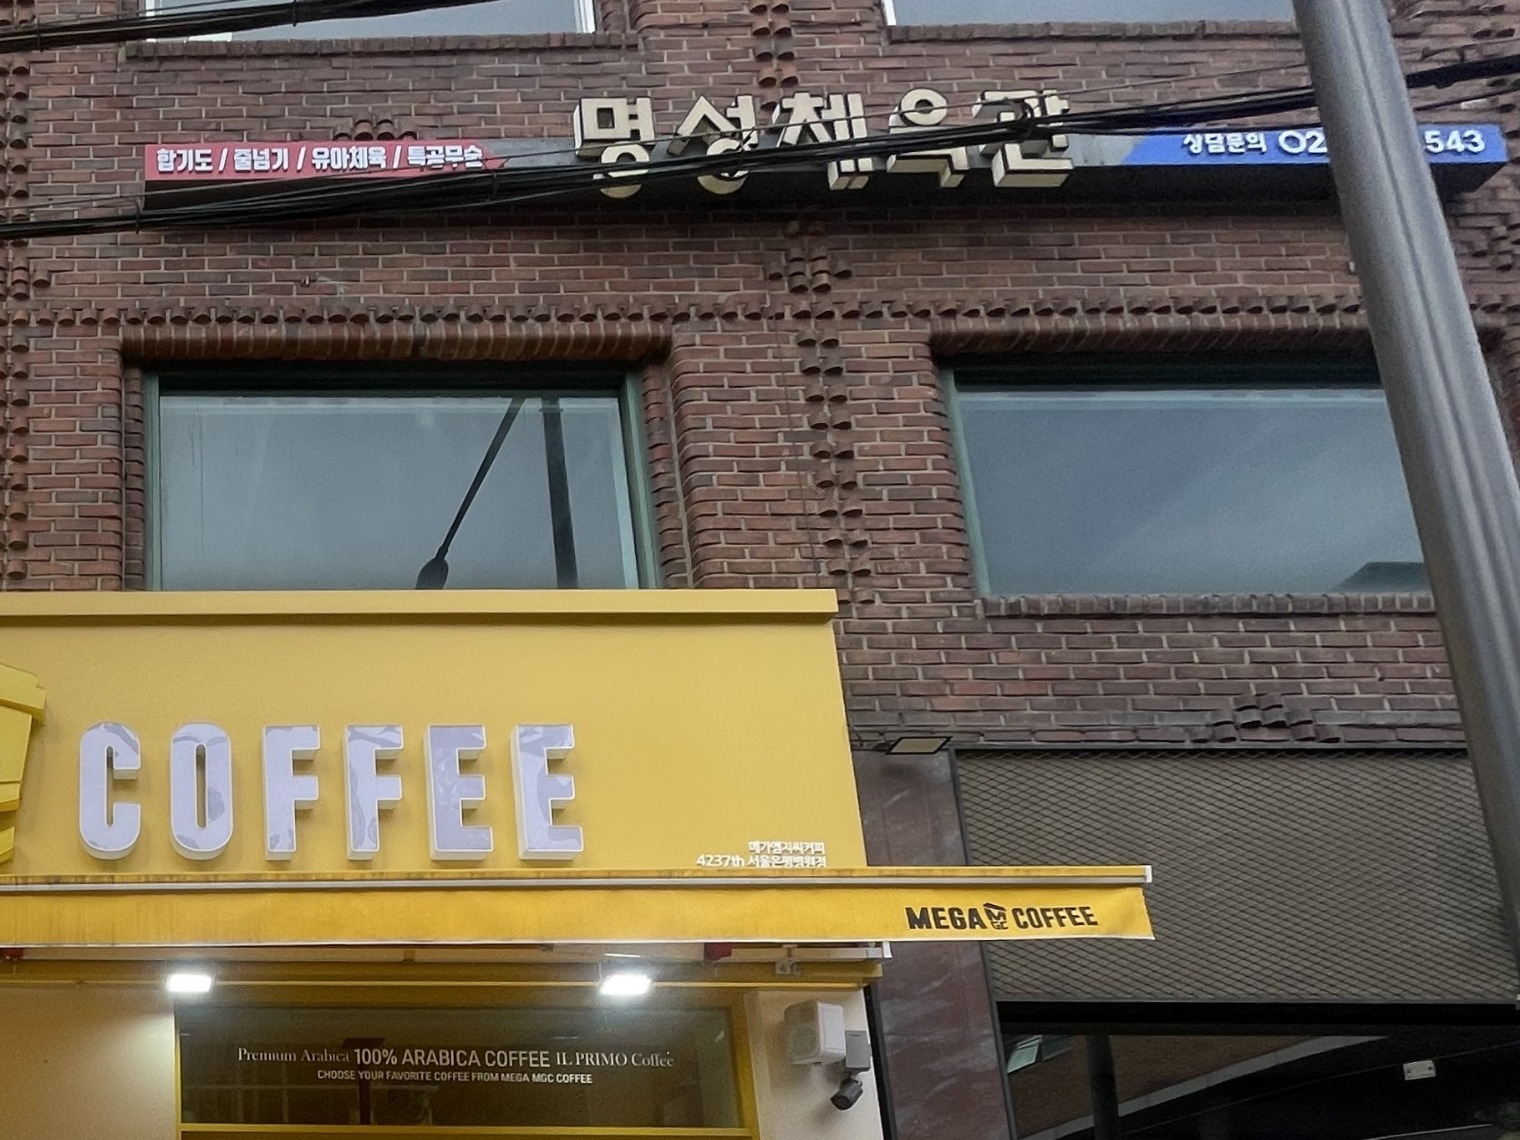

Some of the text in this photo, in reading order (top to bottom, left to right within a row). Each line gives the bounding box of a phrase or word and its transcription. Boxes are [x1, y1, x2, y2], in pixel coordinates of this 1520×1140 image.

[1183, 132, 1267, 154] 상담문의
[156, 148, 213, 171] 합기도
[233, 148, 289, 171] 줄넘기
[311, 147, 386, 170] 유아체육
[406, 145, 484, 168] 특공무술
[79, 722, 584, 861] COFFEE
[696, 855, 745, 867] 4237th
[905, 906, 1098, 930] MEGA COFFEE
[238, 1048, 297, 1062] Premium
[300, 1049, 350, 1062] Arabica
[354, 1048, 398, 1066] 100%
[401, 1049, 481, 1067] ARABICA
[484, 1050, 550, 1067] COFFEE
[576, 1052, 627, 1067] PRIMO
[631, 1052, 674, 1067] Coffee
[317, 1069, 593, 1084] CHOOSE YOUR FAVORITE COFFEE FROM MEGA MGC COFFEE
